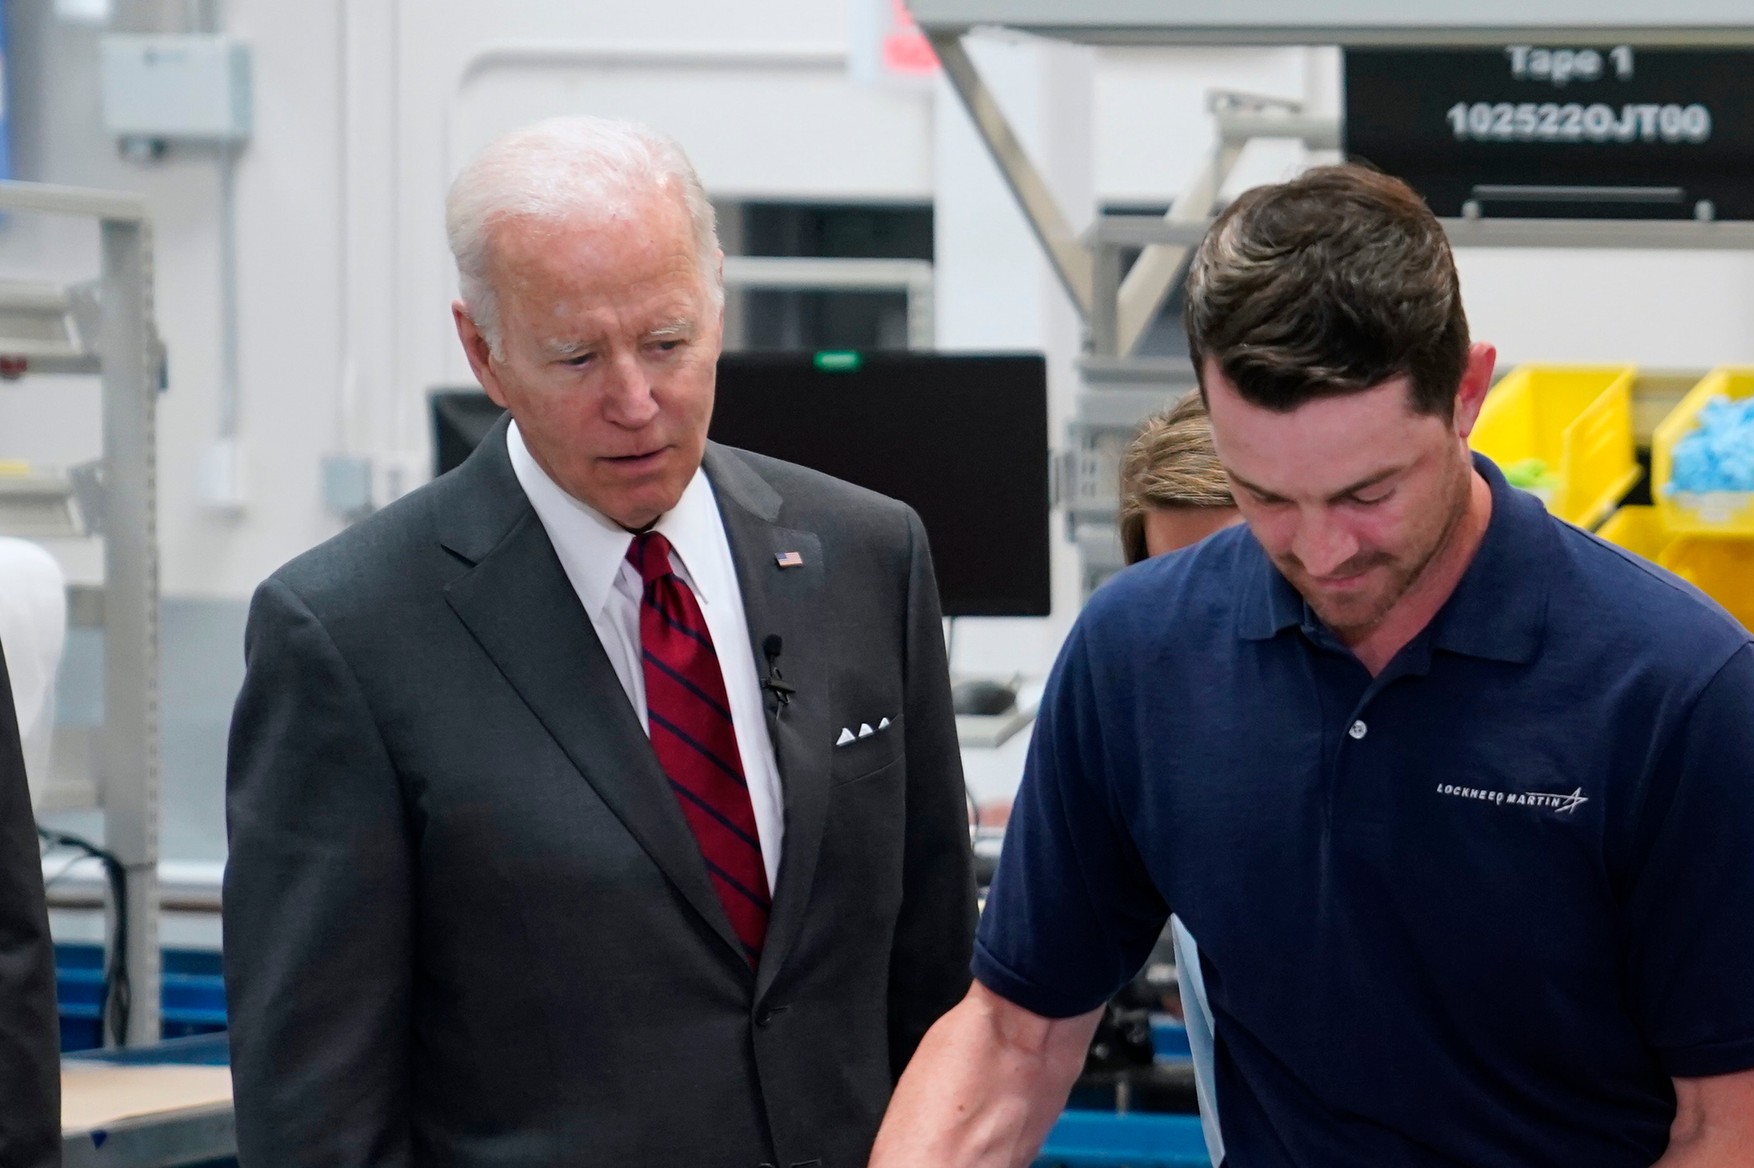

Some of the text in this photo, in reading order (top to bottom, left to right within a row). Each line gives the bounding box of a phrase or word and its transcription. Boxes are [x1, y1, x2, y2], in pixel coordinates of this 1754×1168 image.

[1507, 45, 1633, 86] Tape 1
[1436, 783, 1561, 807] LOCKHEED MARTIN
